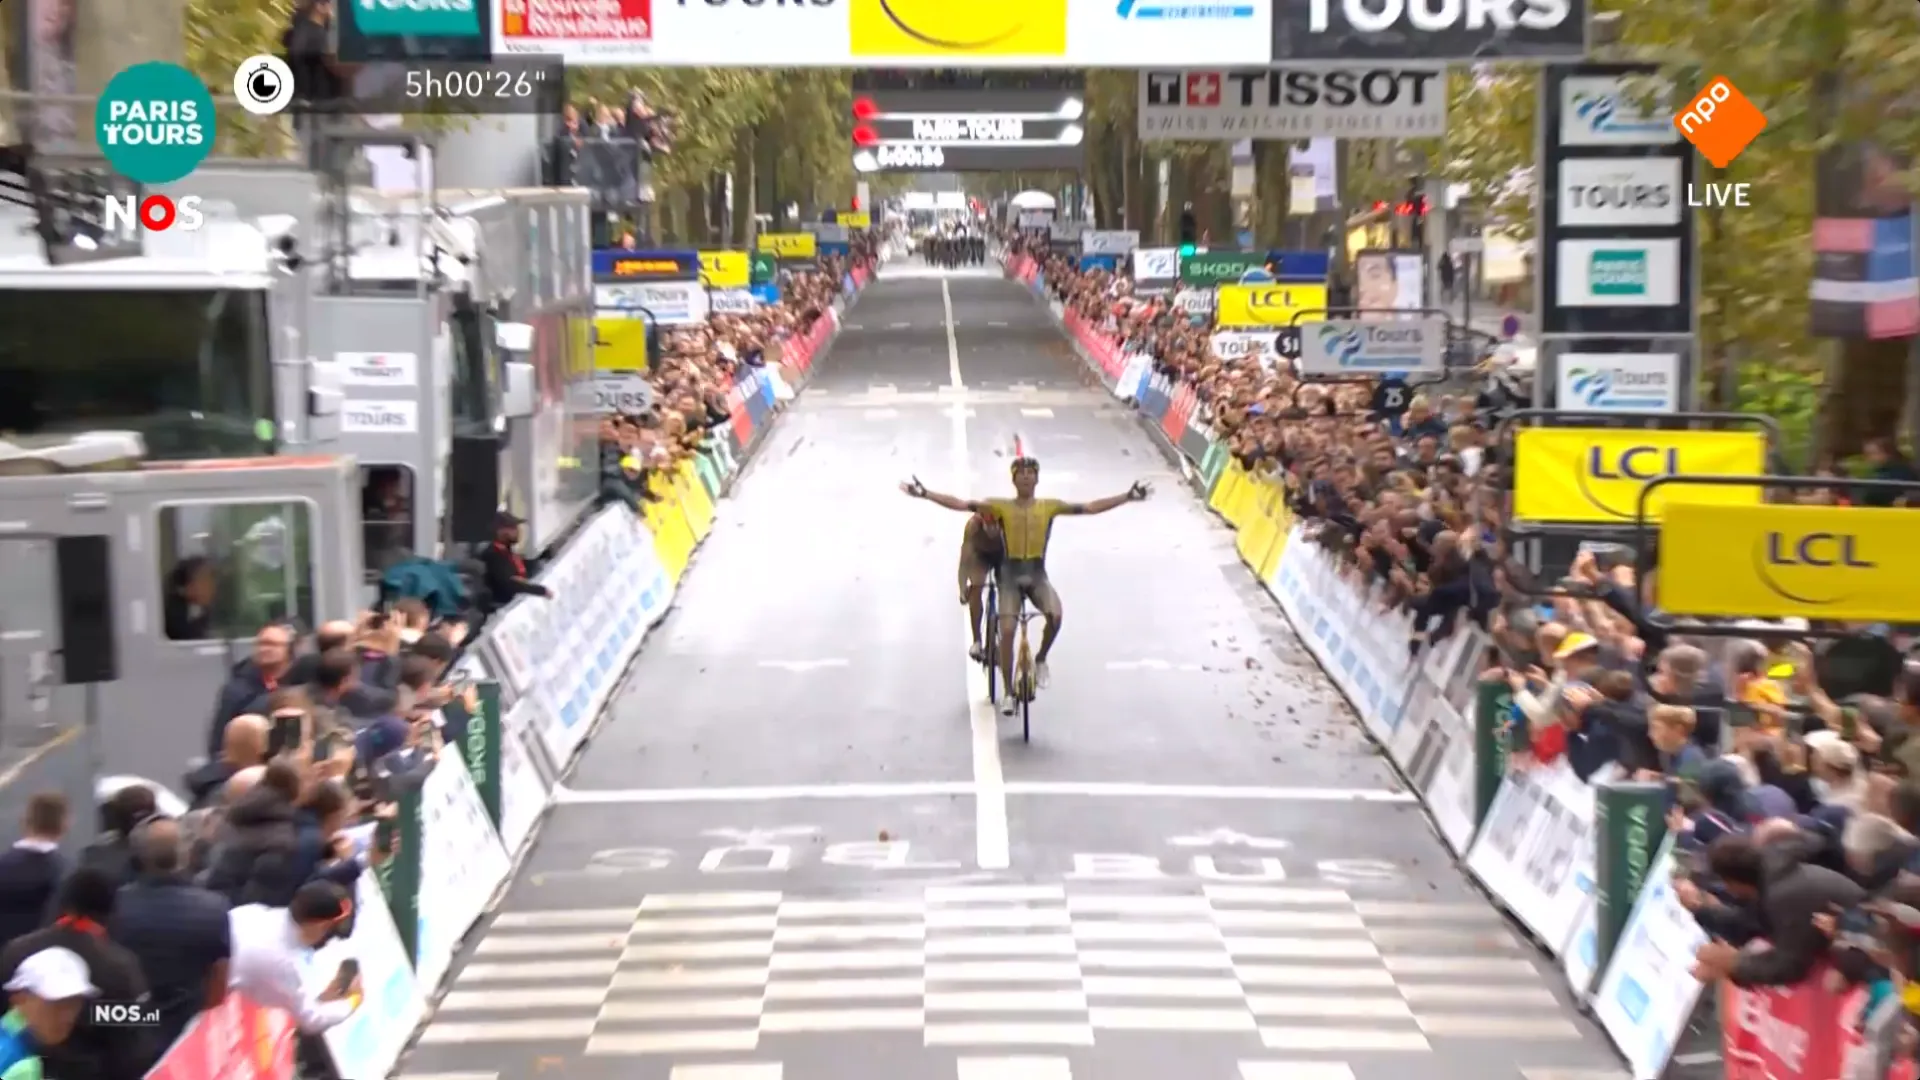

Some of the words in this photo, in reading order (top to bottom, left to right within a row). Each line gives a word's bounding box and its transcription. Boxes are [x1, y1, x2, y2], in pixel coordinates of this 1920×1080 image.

[1228, 69, 1439, 107] TISSOT
[1568, 183, 1671, 209] TOURS
[1251, 289, 1298, 308] LCL
[1366, 326, 1424, 344] Tours
[1219, 341, 1270, 355] TOUS
[1612, 367, 1668, 385] Tours
[593, 391, 645, 409] OURS
[1767, 532, 1878, 568] LCL
